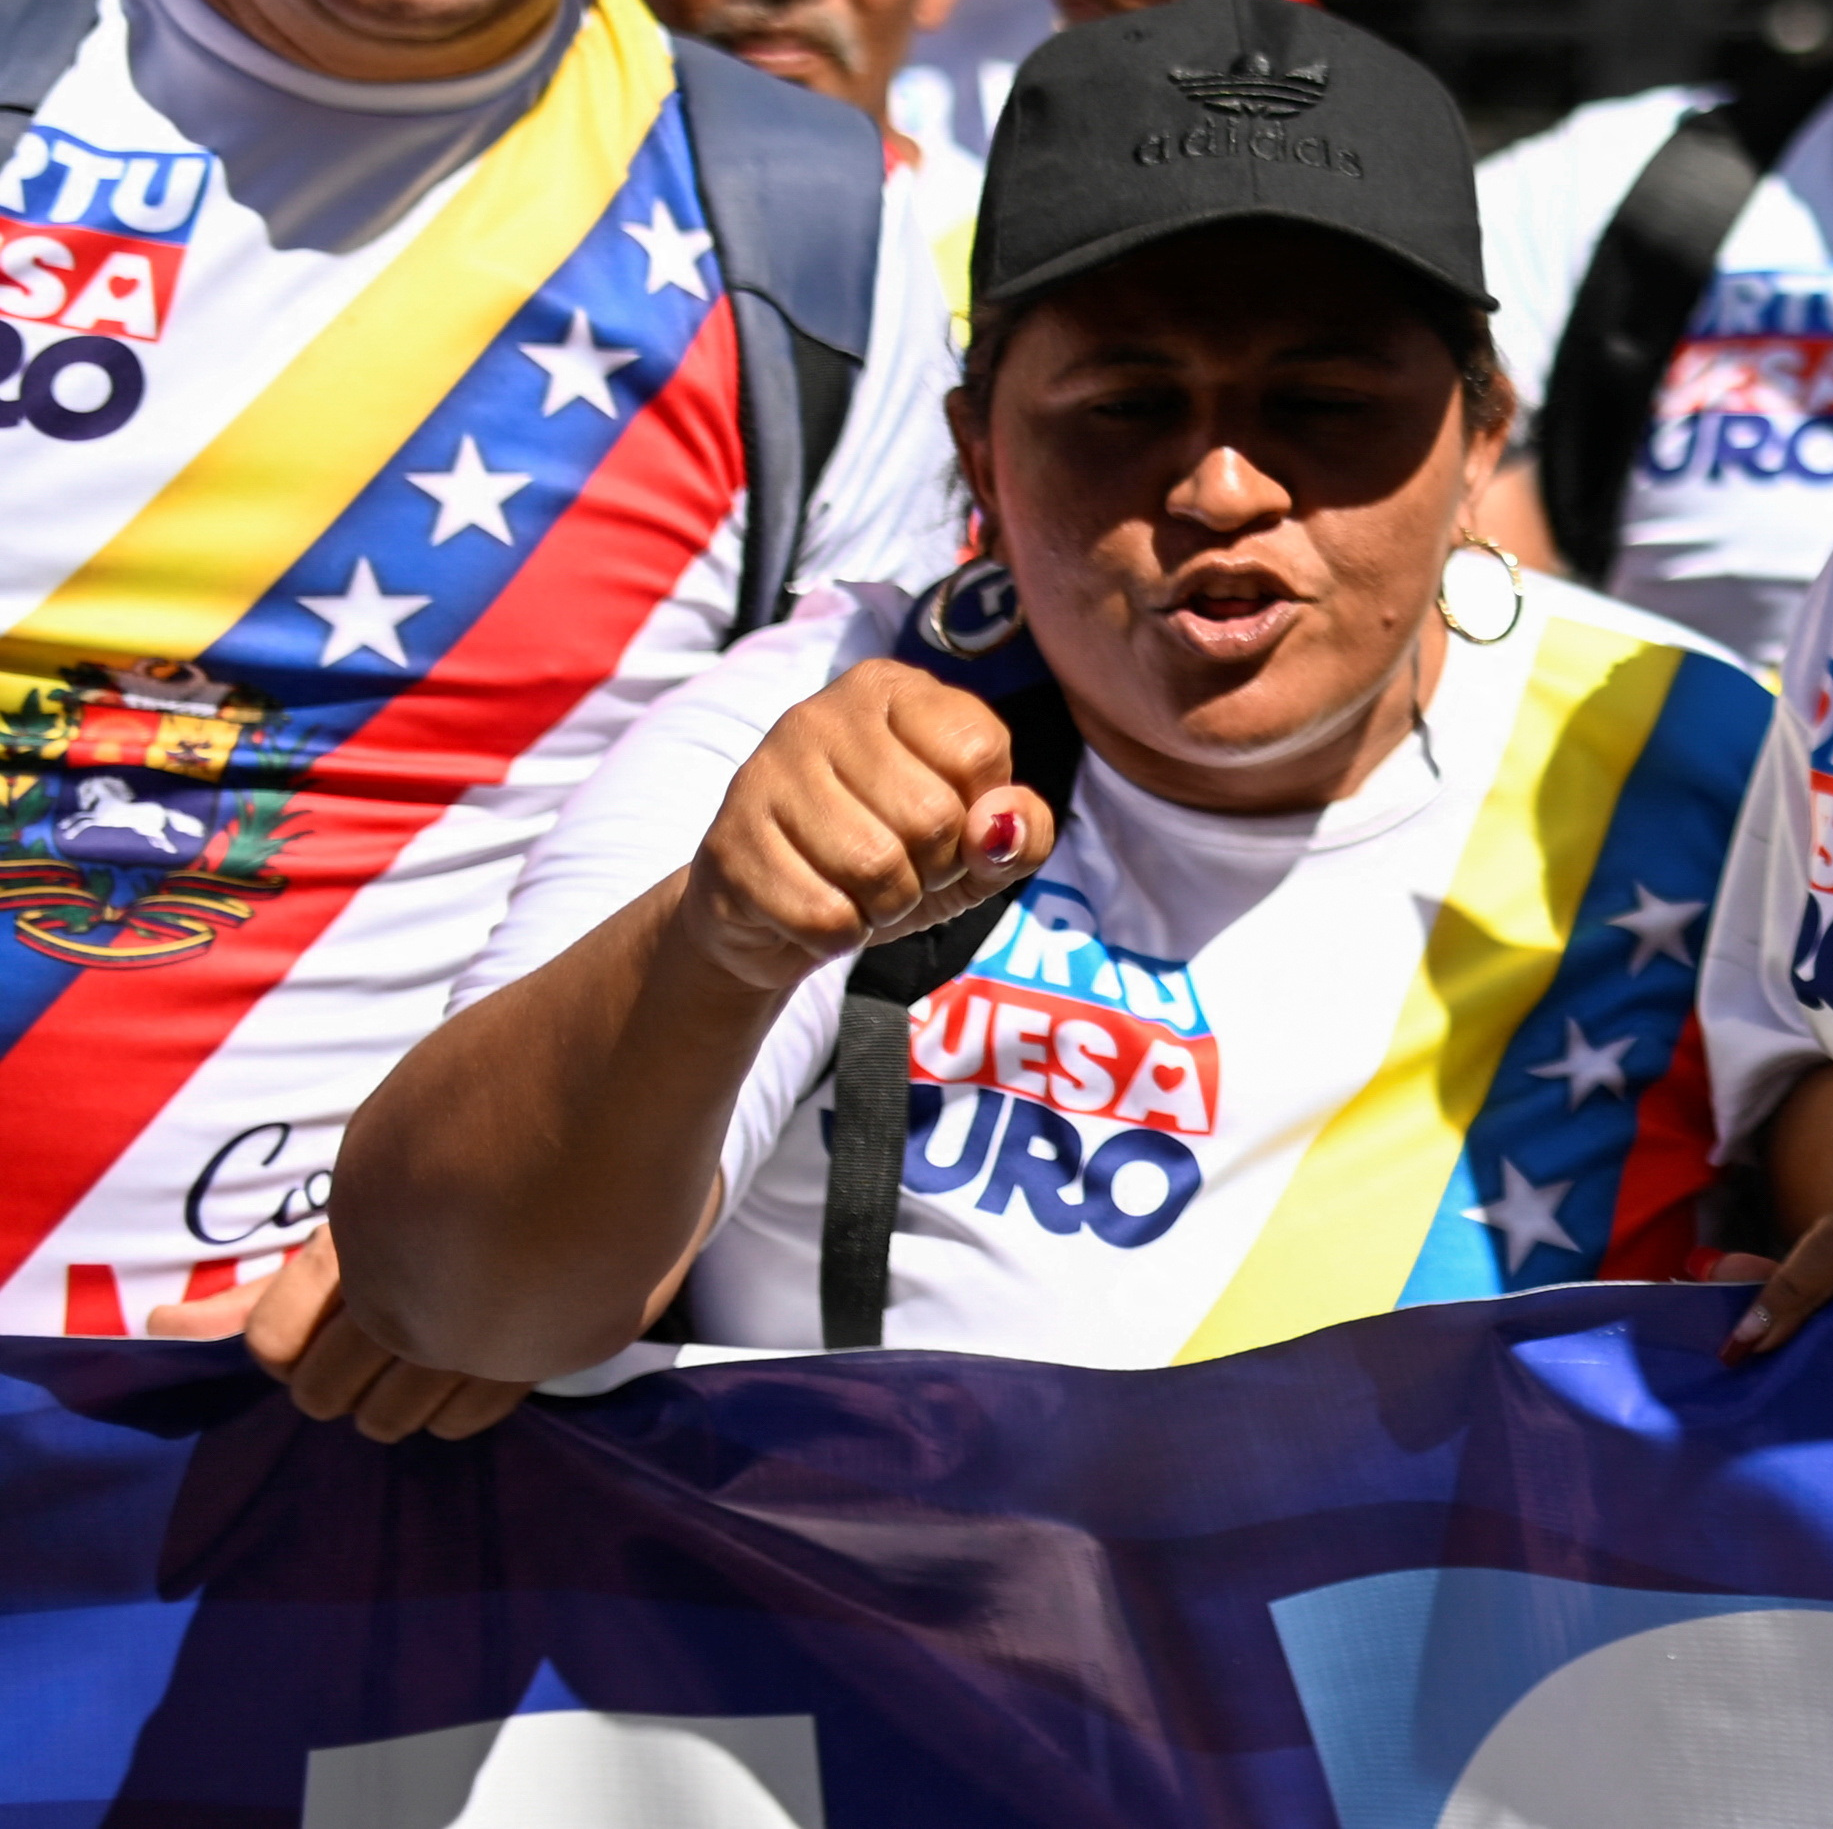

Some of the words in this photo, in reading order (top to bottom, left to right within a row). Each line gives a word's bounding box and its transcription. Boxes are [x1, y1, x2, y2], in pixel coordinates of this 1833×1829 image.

[1133, 117, 1364, 180] adidas
[908, 992, 1210, 1134] UESA
[819, 1083, 1204, 1249] URO
